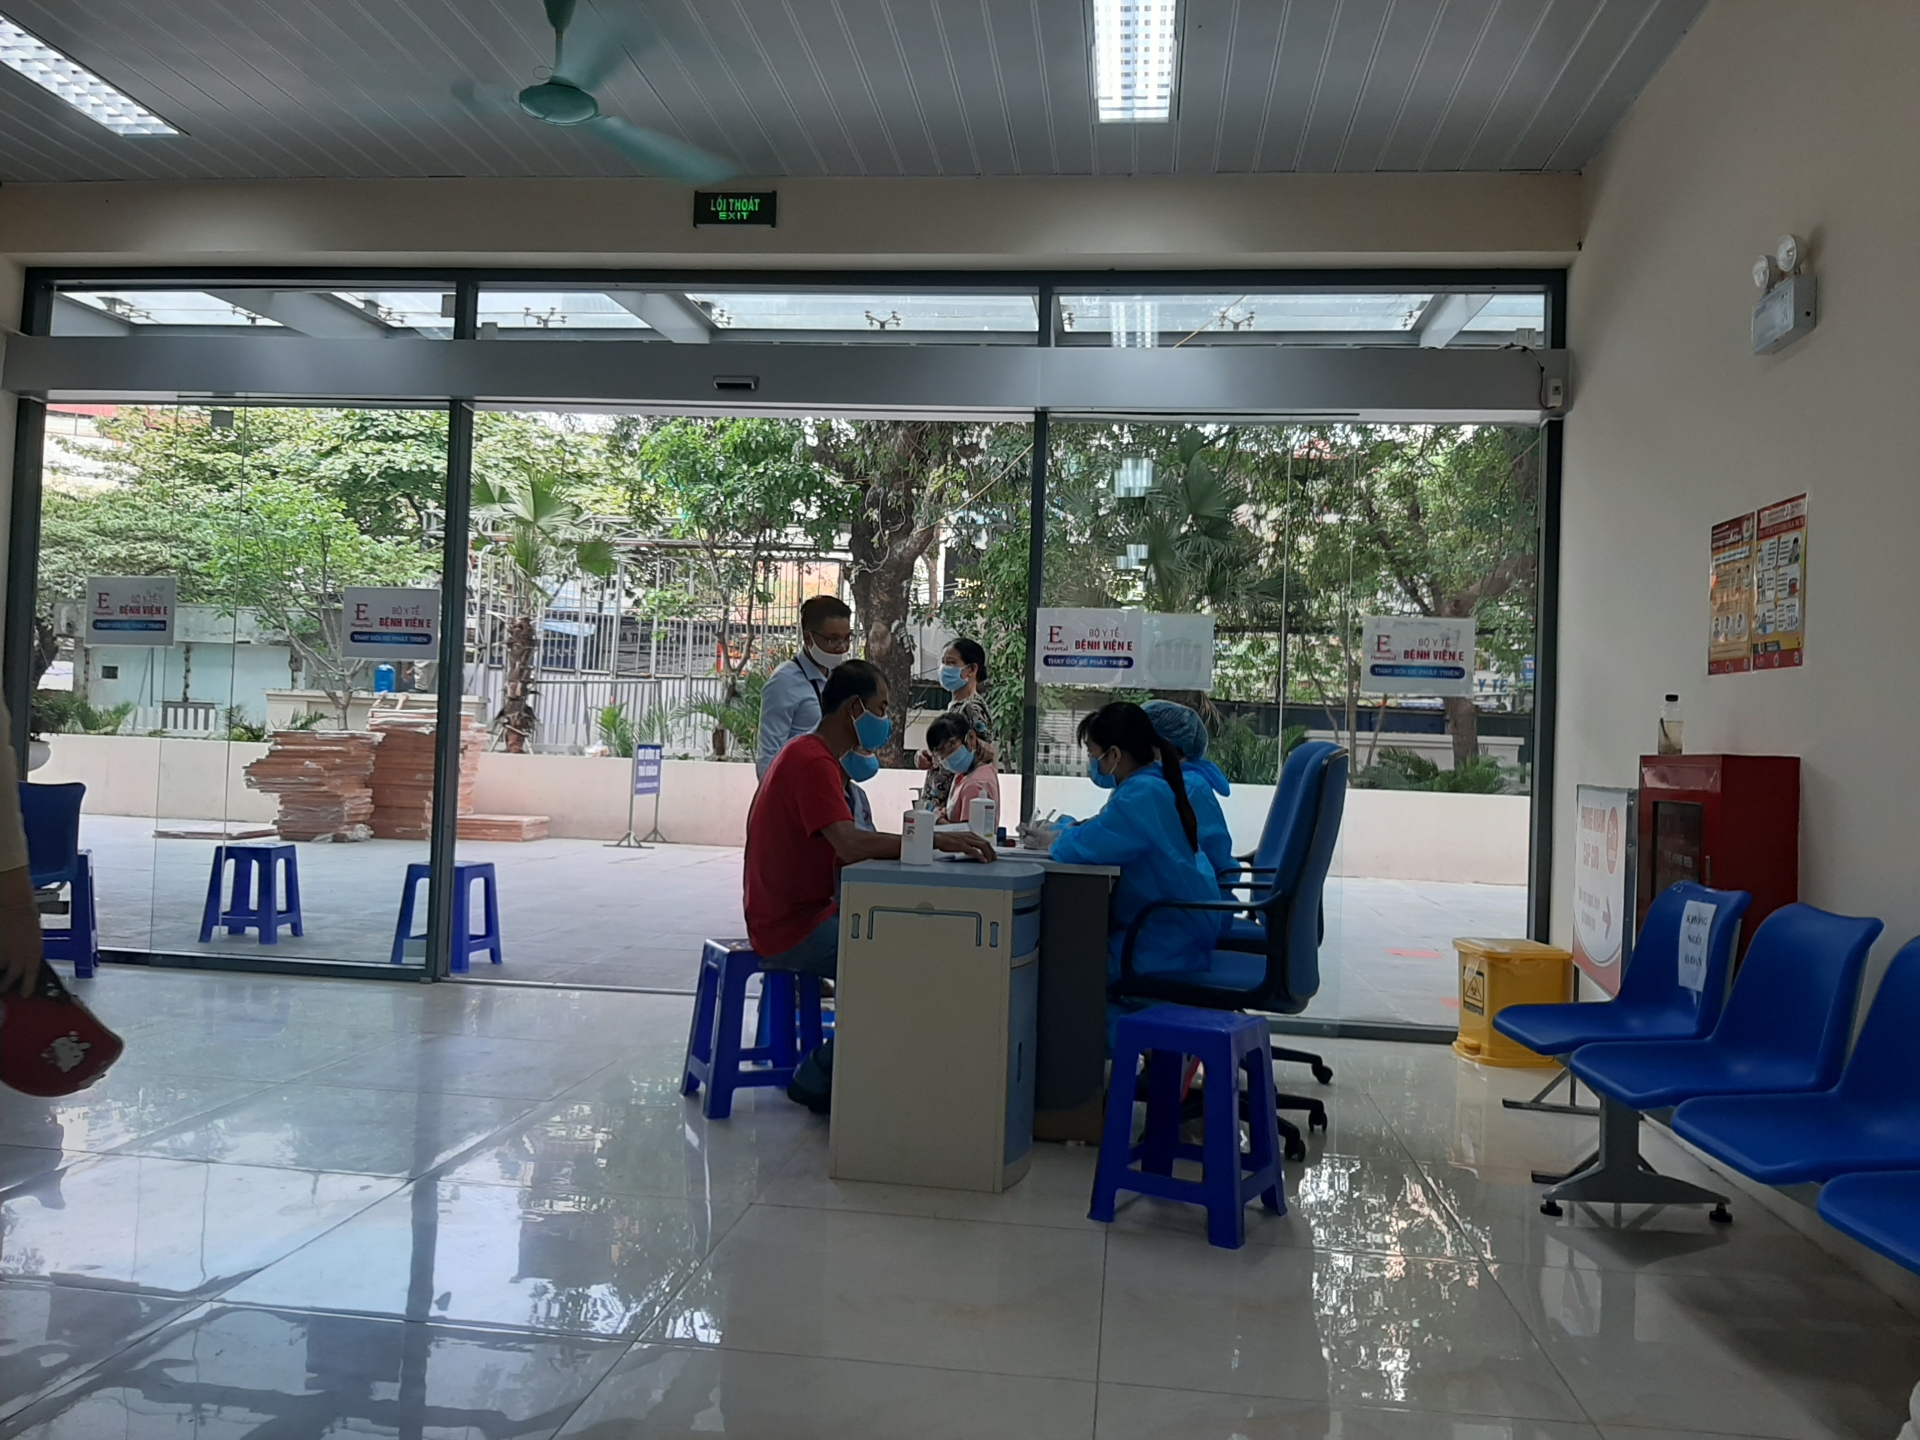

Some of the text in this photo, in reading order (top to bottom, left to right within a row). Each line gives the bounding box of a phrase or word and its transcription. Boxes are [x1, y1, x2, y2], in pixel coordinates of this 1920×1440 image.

[728, 196, 761, 211] THOÁT
[718, 211, 749, 220] EXIT
[119, 604, 141, 617] BỆNH
[142, 604, 162, 617] VIỆN
[164, 606, 168, 615] E
[404, 606, 409, 615] Y
[379, 616, 432, 630] BỆNH VIỆN E
[1088, 626, 1120, 639] BỘ Y TẾ
[1074, 638, 1133, 653] BỆNH VIỆN E
[1418, 637, 1451, 648] BỘ Y TẾ
[1403, 649, 1465, 663] BỆNH VIỆN E
